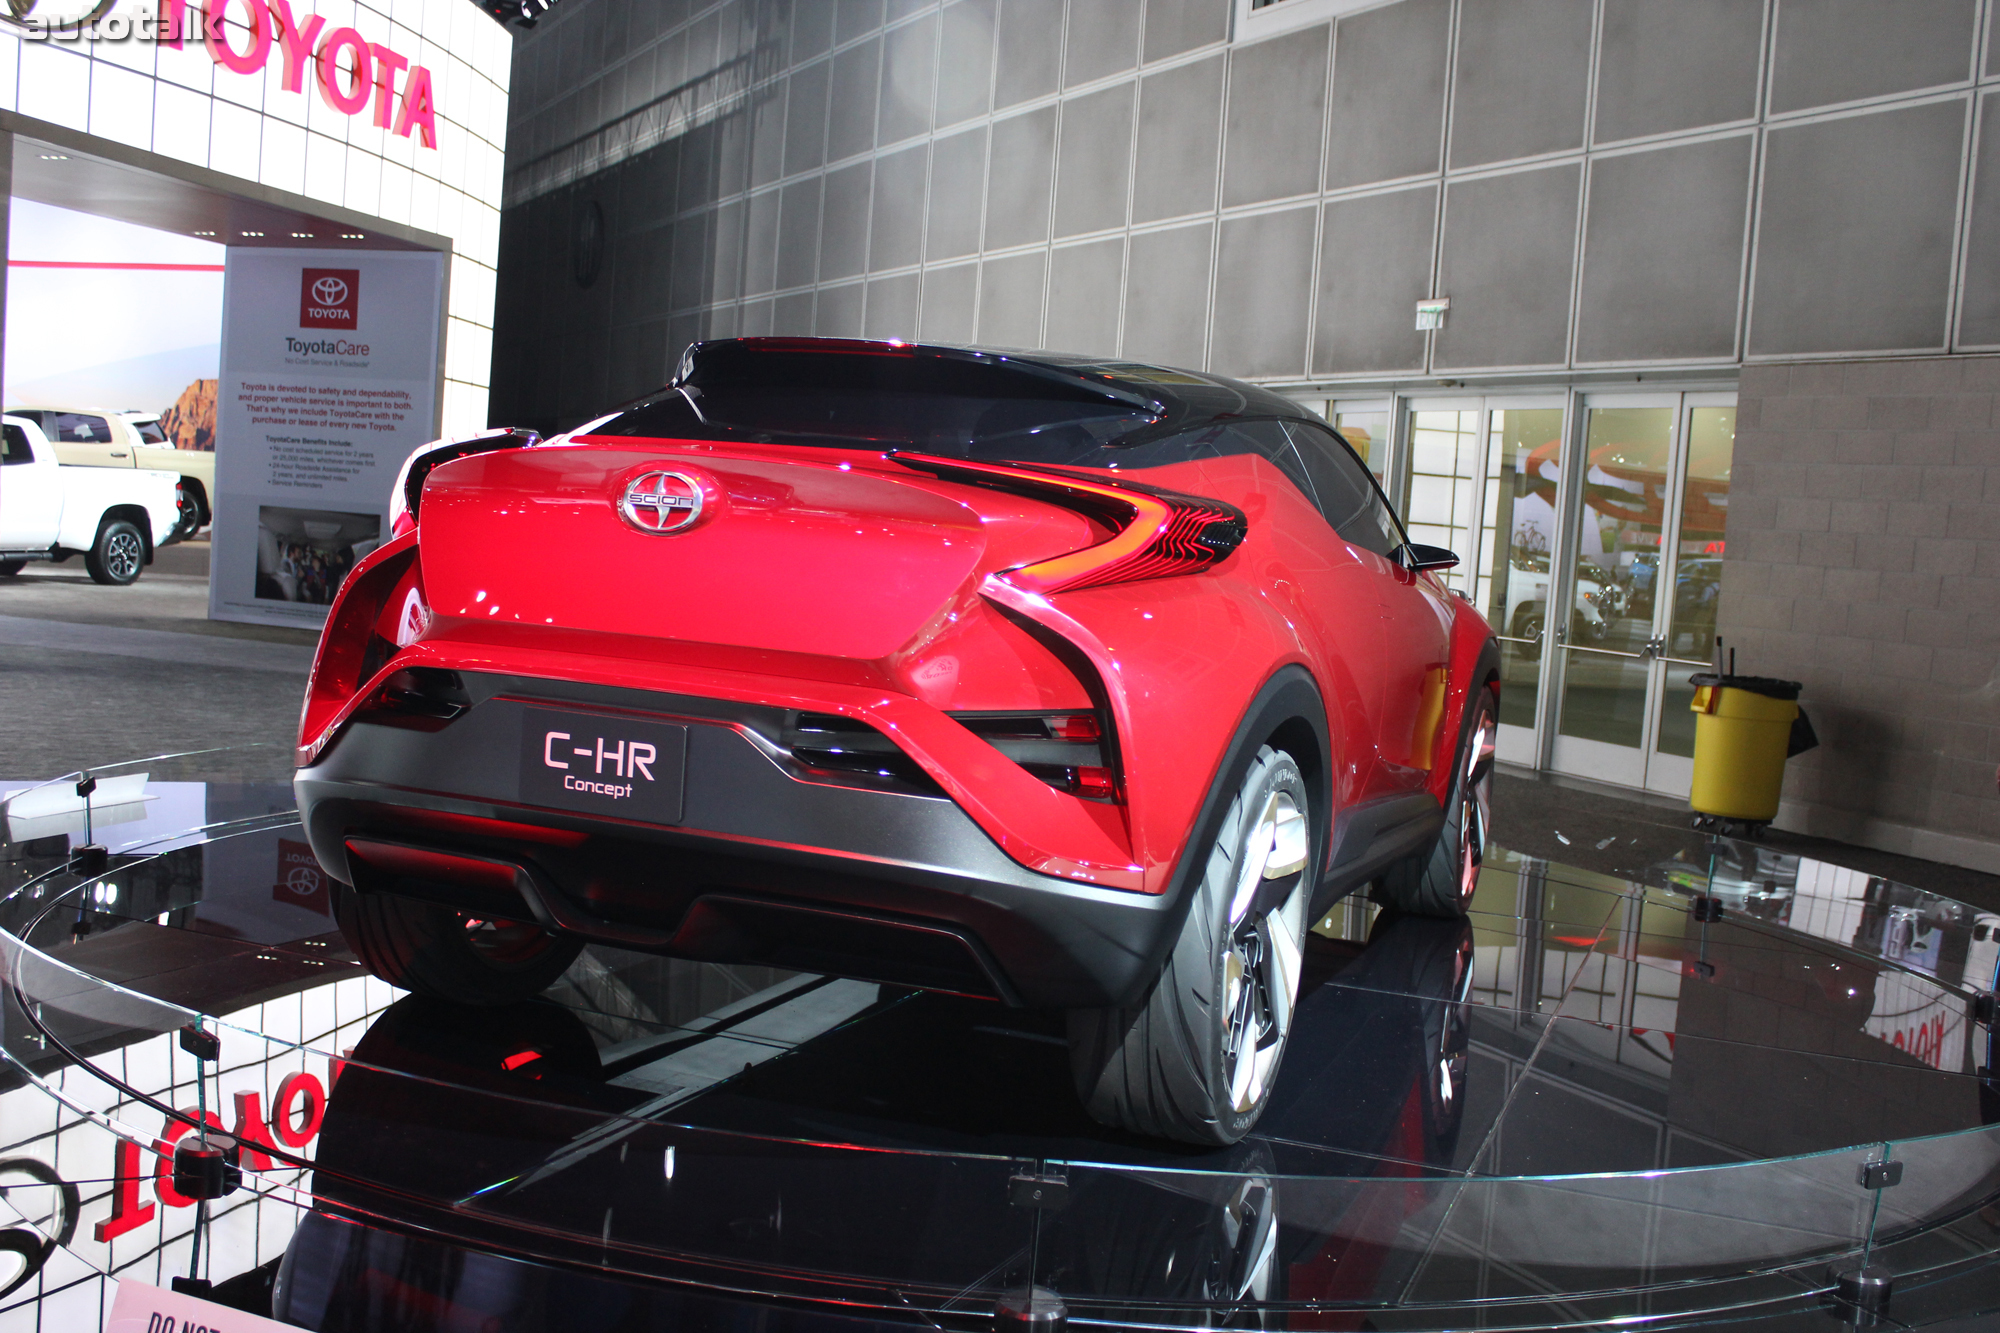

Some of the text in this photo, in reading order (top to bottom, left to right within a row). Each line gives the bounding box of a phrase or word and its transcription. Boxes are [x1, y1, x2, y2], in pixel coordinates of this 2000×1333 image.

[308, 308, 351, 319] TOYOTA
[286, 338, 370, 356] ToyotaCare
[241, 382, 266, 392] Toyota
[277, 385, 307, 393] devoted
[318, 388, 341, 397] safety
[359, 389, 411, 400] dependability,
[254, 396, 278, 404] proper
[346, 400, 382, 409] important
[394, 402, 413, 410] both.
[246, 404, 269, 412] That's
[271, 407, 286, 415] why
[301, 408, 328, 416] include
[330, 409, 372, 419] ToyotaCare
[299, 418, 318, 426] lease
[329, 422, 350, 430] every
[369, 422, 396, 432] Toyota.
[266, 435, 301, 444] ToyotaCare
[629, 494, 694, 507] SCION
[544, 731, 657, 781] C-HR
[564, 775, 633, 799] Concept
